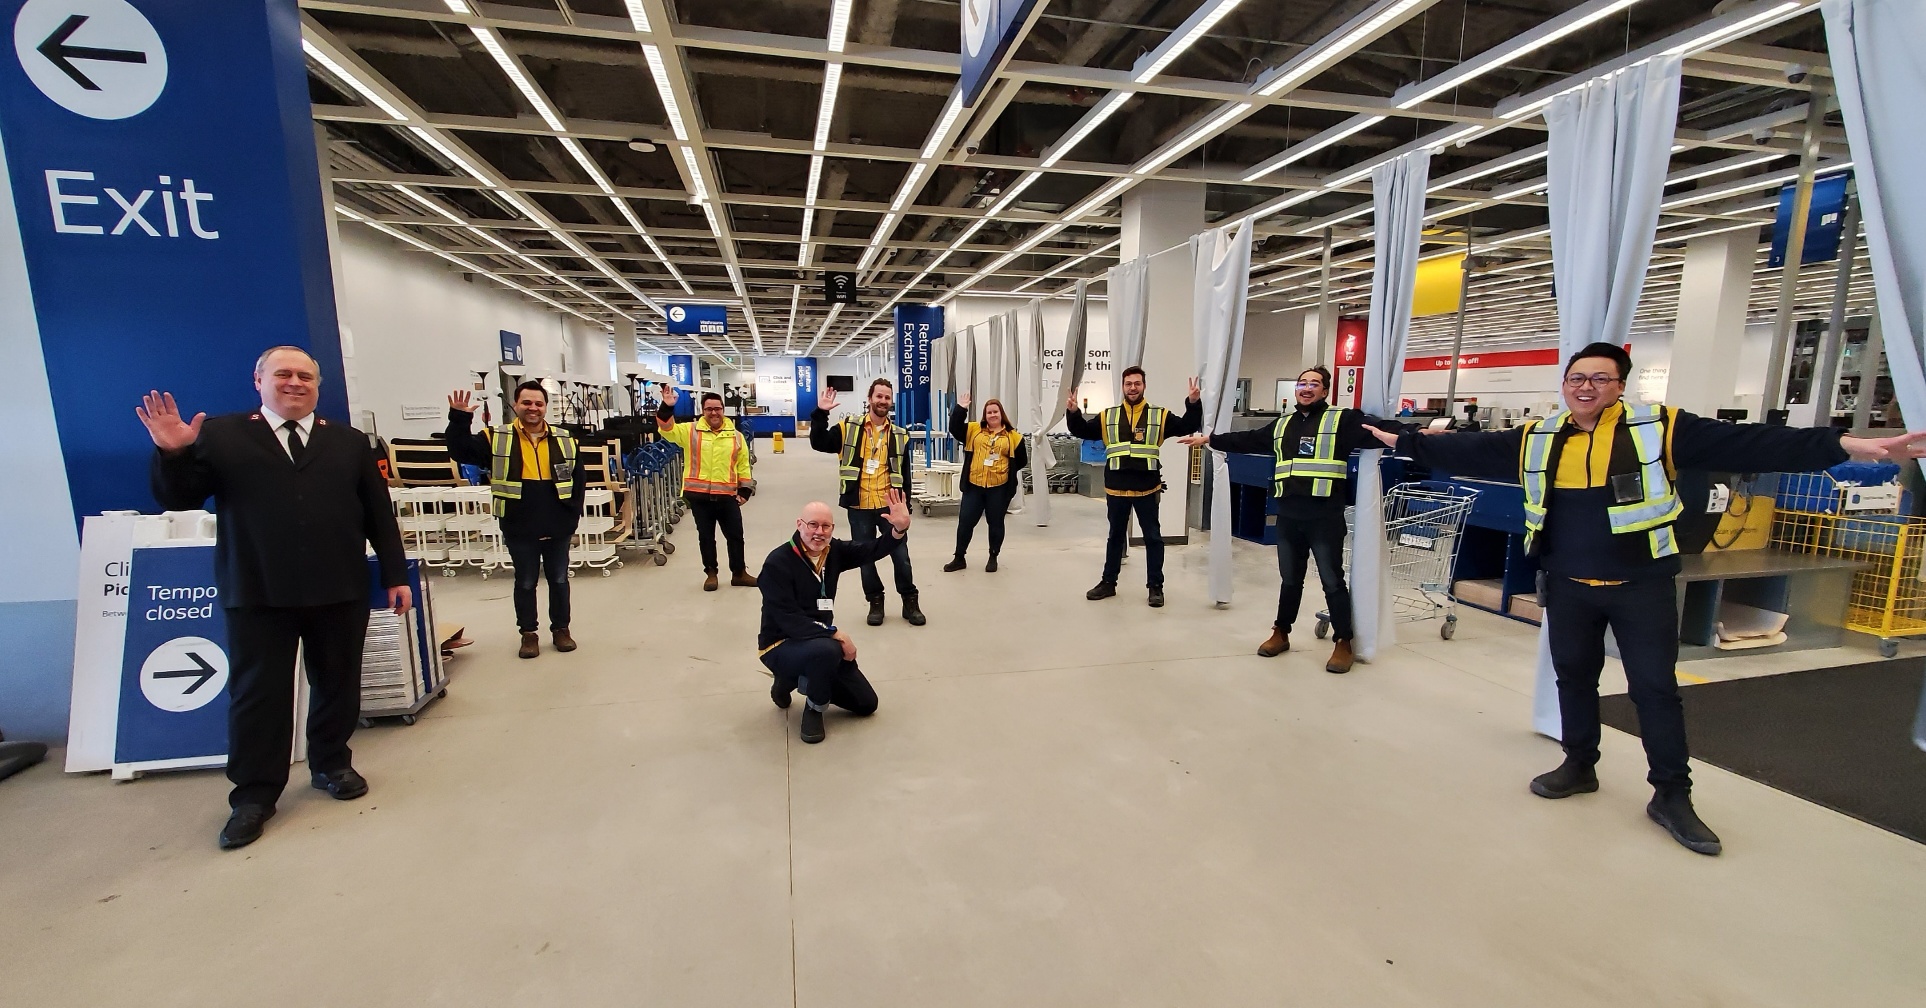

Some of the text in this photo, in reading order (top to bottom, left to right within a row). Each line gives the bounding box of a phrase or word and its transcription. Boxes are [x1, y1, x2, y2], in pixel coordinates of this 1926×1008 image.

[45, 170, 219, 240] Exit
[902, 323, 915, 389] Exchanges
[919, 323, 929, 386] Returns &
[105, 561, 129, 577] Cli
[145, 602, 213, 621] closed
[147, 585, 218, 602] Tempo
